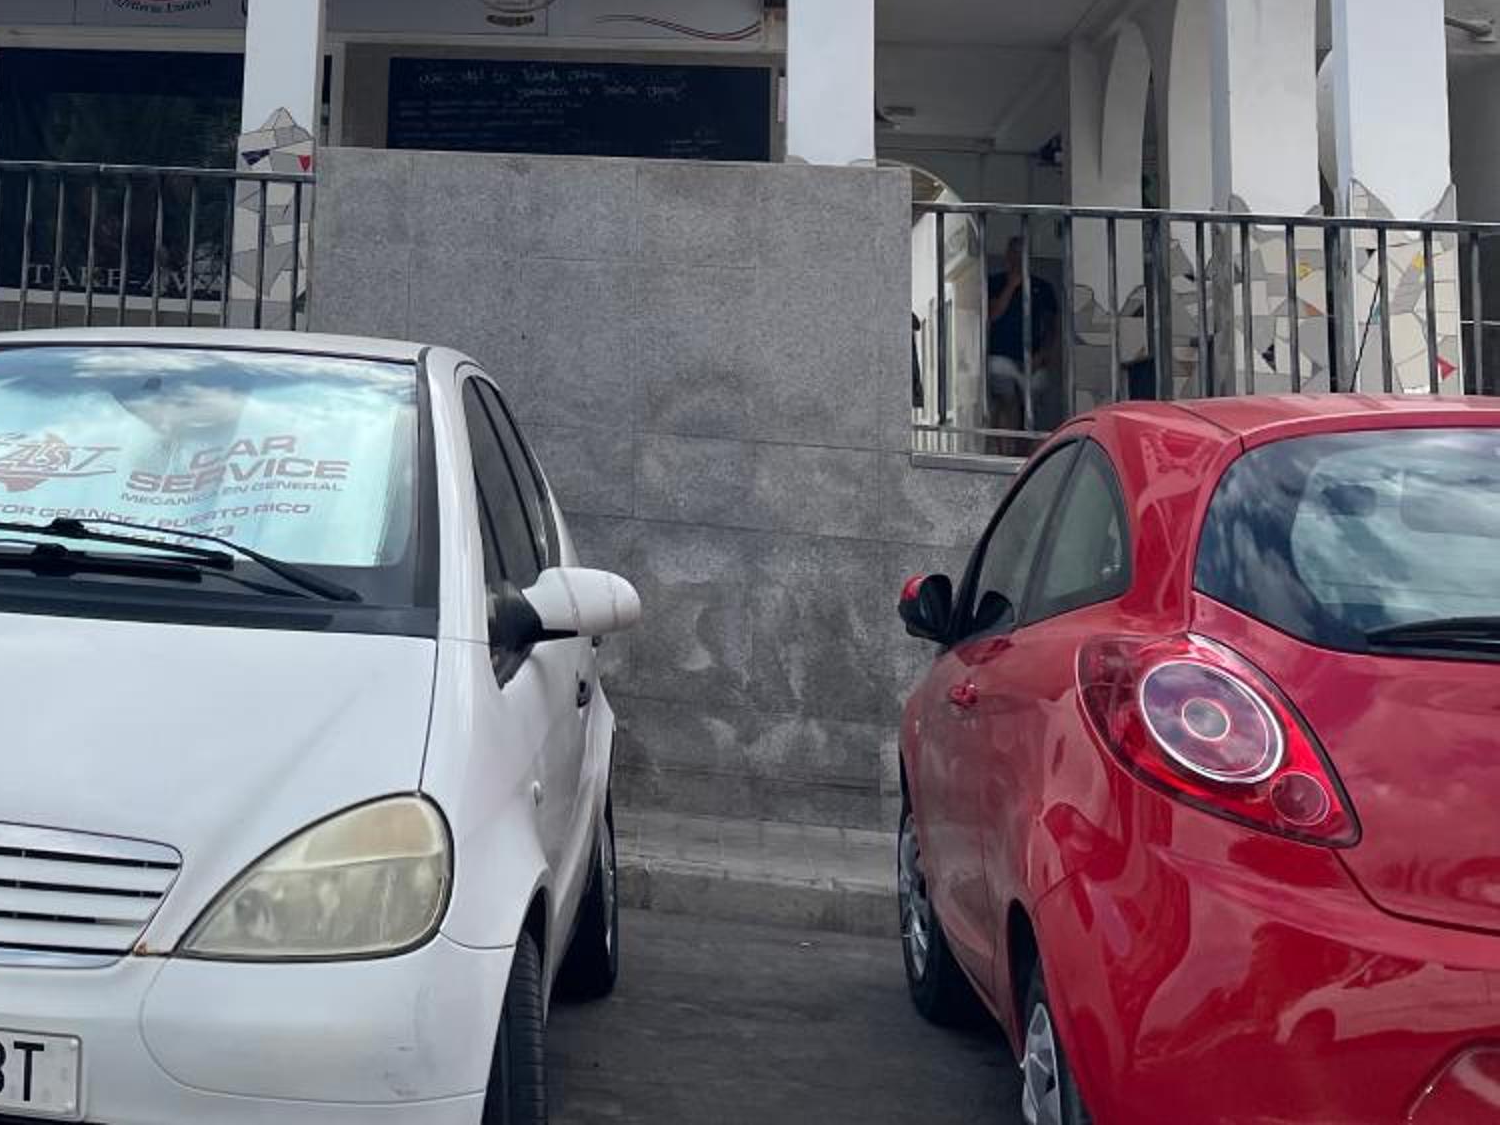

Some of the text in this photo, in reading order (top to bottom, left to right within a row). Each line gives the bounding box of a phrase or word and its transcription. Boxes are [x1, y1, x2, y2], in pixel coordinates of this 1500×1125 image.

[190, 434, 297, 473] CAR
[126, 457, 350, 494] SERVICE
[254, 502, 312, 515] RICO
